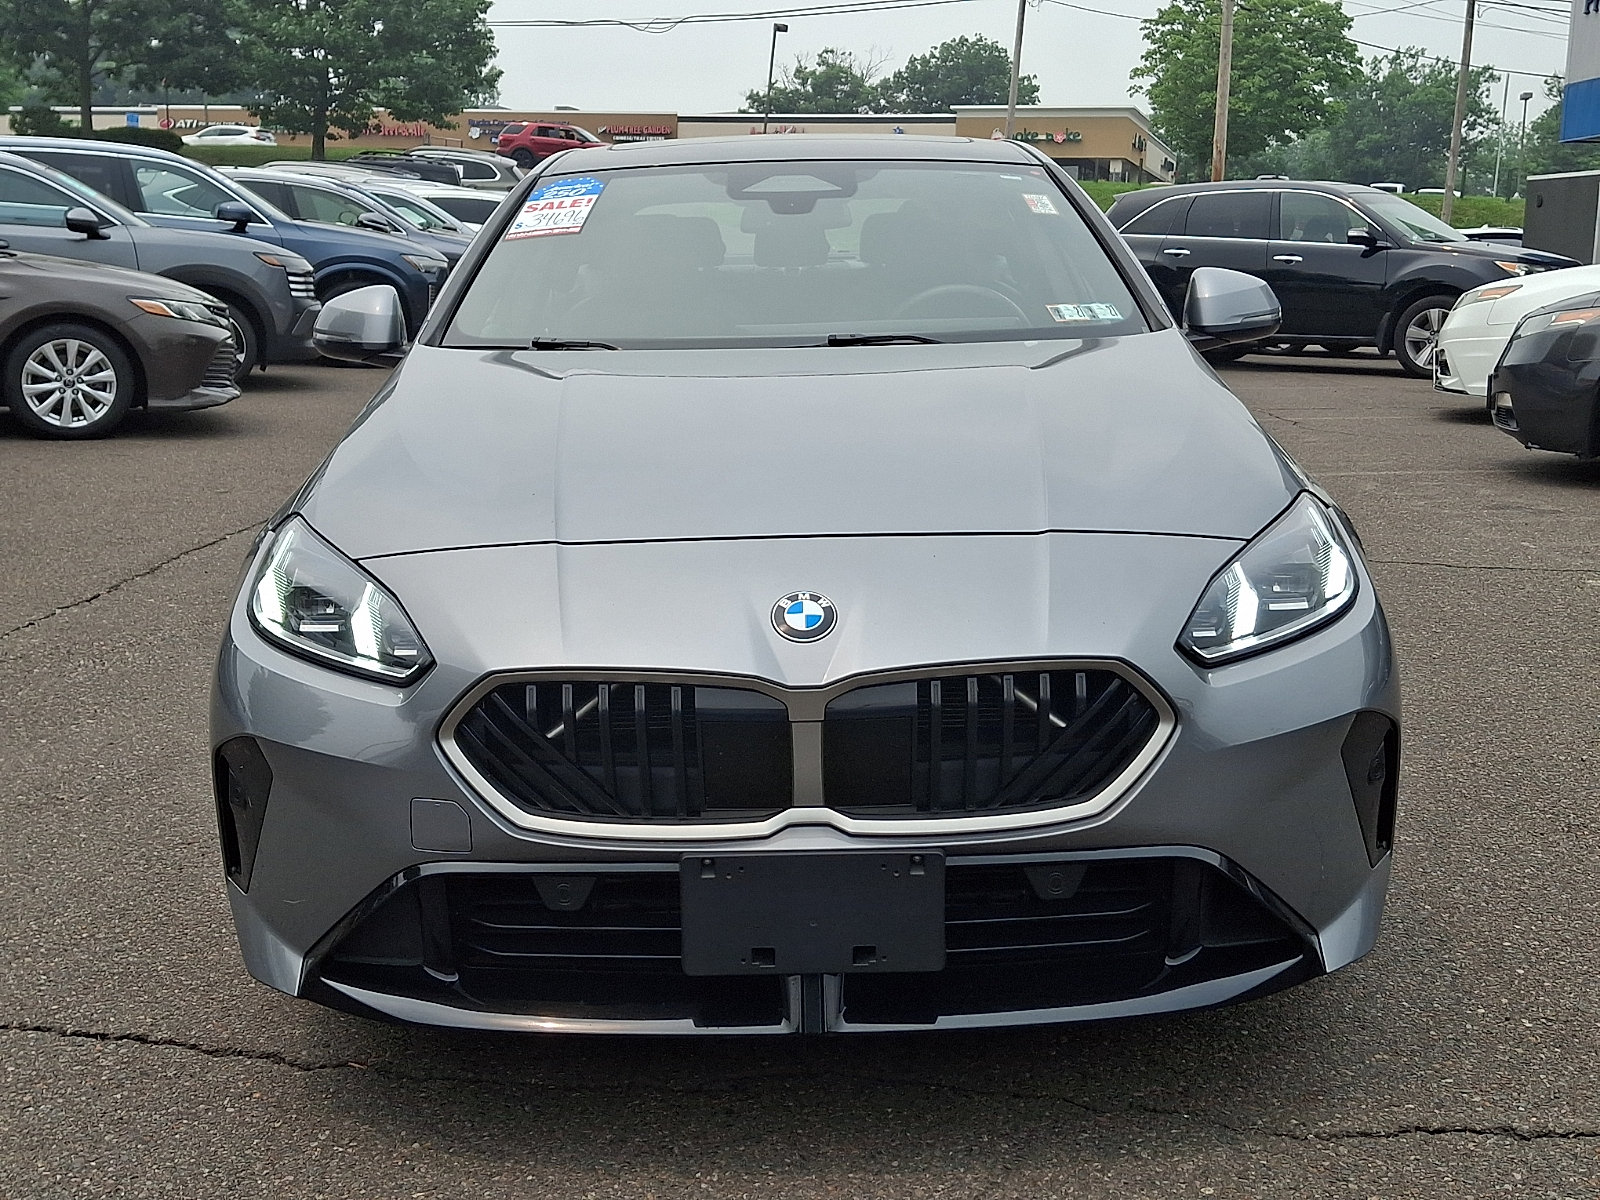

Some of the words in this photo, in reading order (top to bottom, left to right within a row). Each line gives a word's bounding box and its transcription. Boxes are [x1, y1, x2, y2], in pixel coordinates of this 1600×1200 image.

[175, 119, 198, 129] ATI
[524, 197, 594, 213] SALE!
[778, 593, 831, 609] BMW
